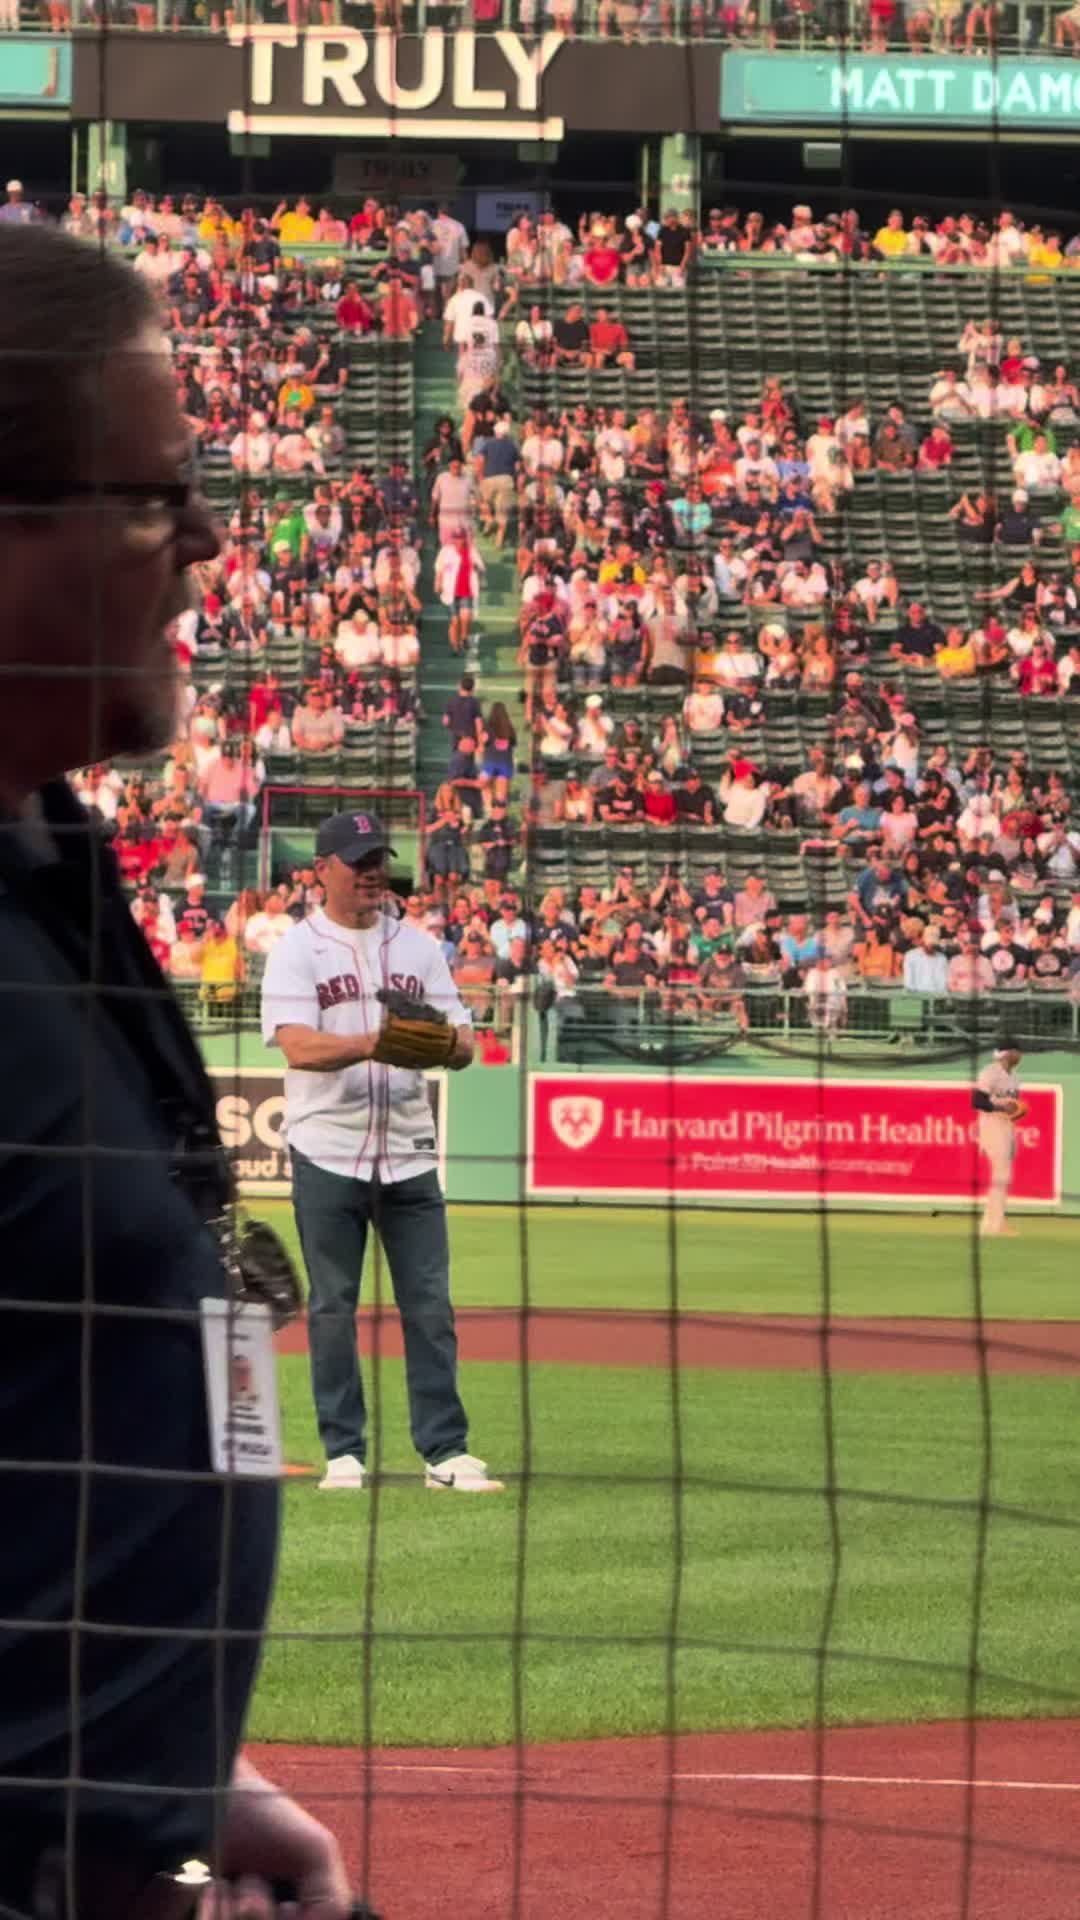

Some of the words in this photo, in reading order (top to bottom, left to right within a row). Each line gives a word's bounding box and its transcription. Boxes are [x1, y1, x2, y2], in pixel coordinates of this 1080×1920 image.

[228, 23, 566, 111] TRULY
[829, 66, 957, 110] MATT
[971, 71, 1080, 115] DAM
[354, 815, 372, 834] B
[316, 973, 361, 1011] RED
[613, 1108, 739, 1140] Harvard
[744, 1111, 856, 1150] Pilgrim
